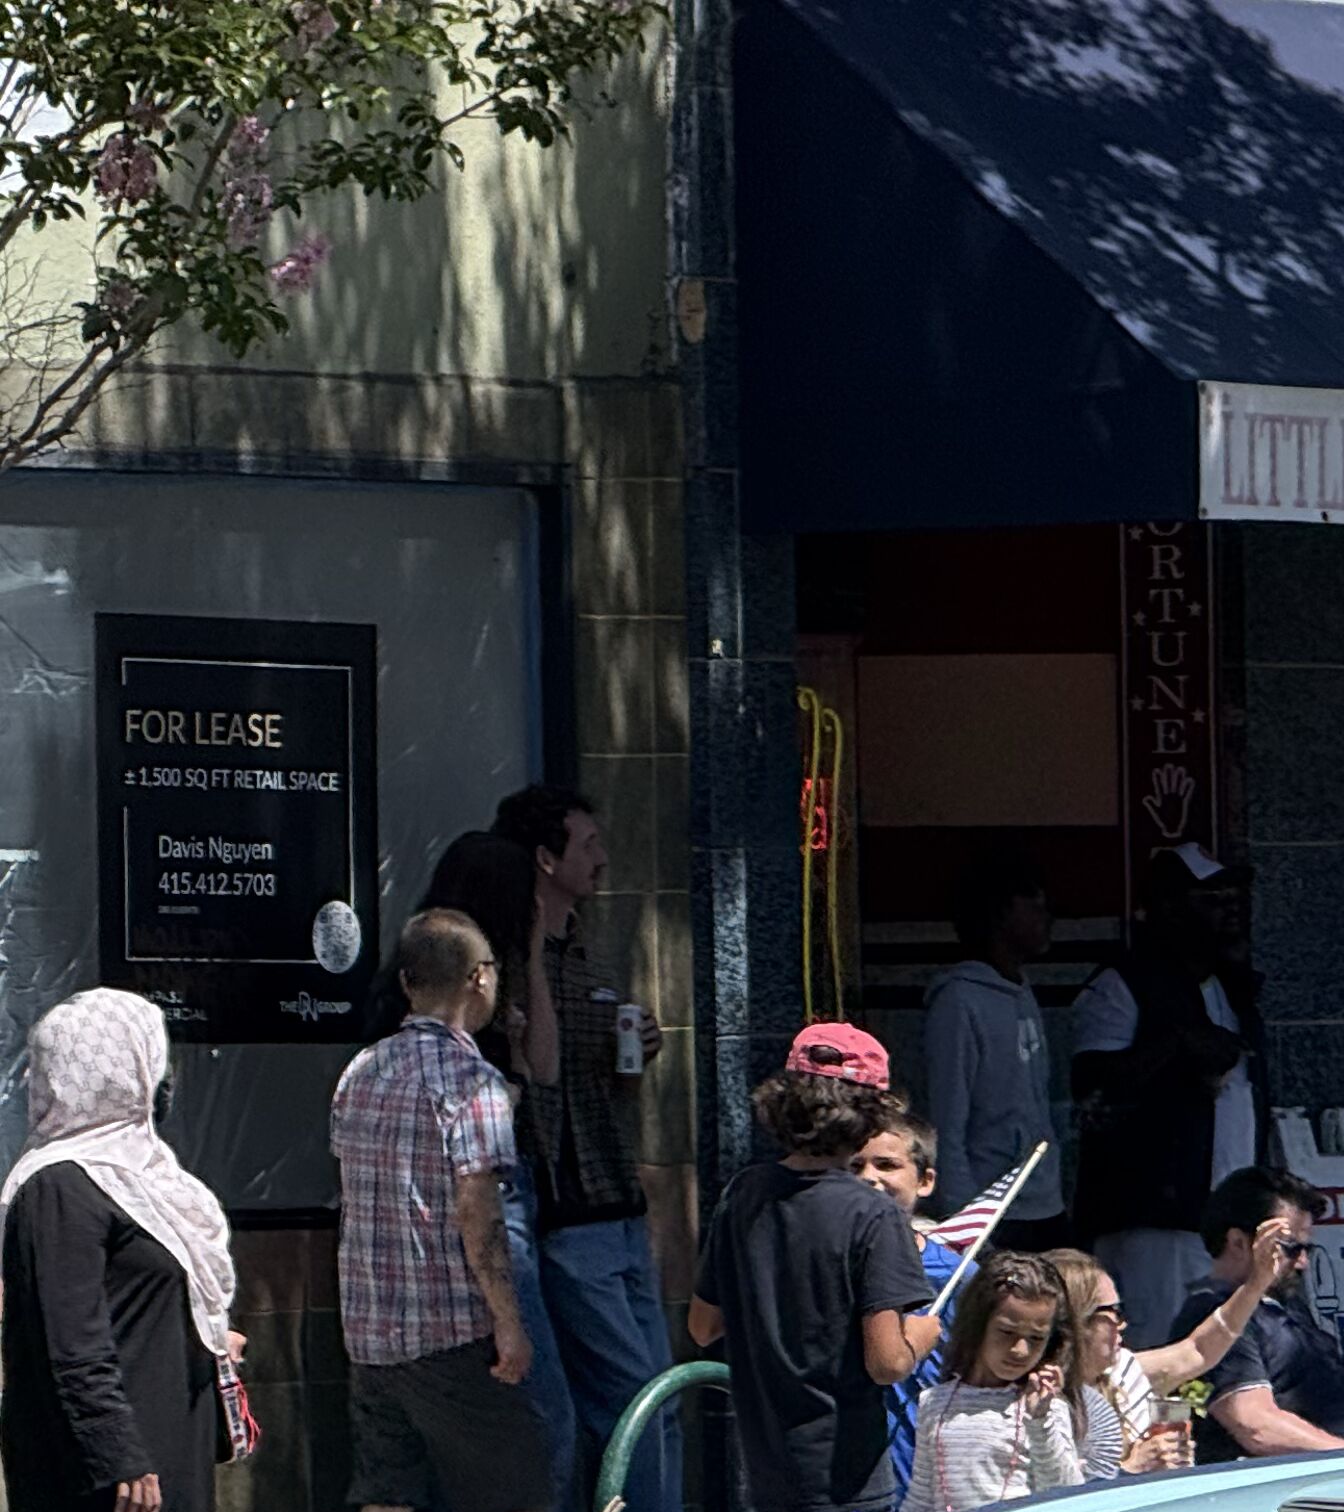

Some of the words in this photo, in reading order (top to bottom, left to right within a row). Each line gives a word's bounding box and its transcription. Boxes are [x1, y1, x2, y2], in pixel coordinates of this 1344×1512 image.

[1147, 522, 1189, 754] RTUNE
[125, 710, 187, 744] FOR
[195, 711, 284, 748] LEASE
[140, 768, 181, 787] 1,500
[185, 769, 208, 790] SQ
[211, 770, 231, 787] FT
[234, 770, 286, 790] RETAIL
[289, 771, 341, 792] SPACE
[158, 835, 204, 858] Davis
[208, 836, 273, 864] Nguyen
[158, 872, 276, 896] 415.412.5703
